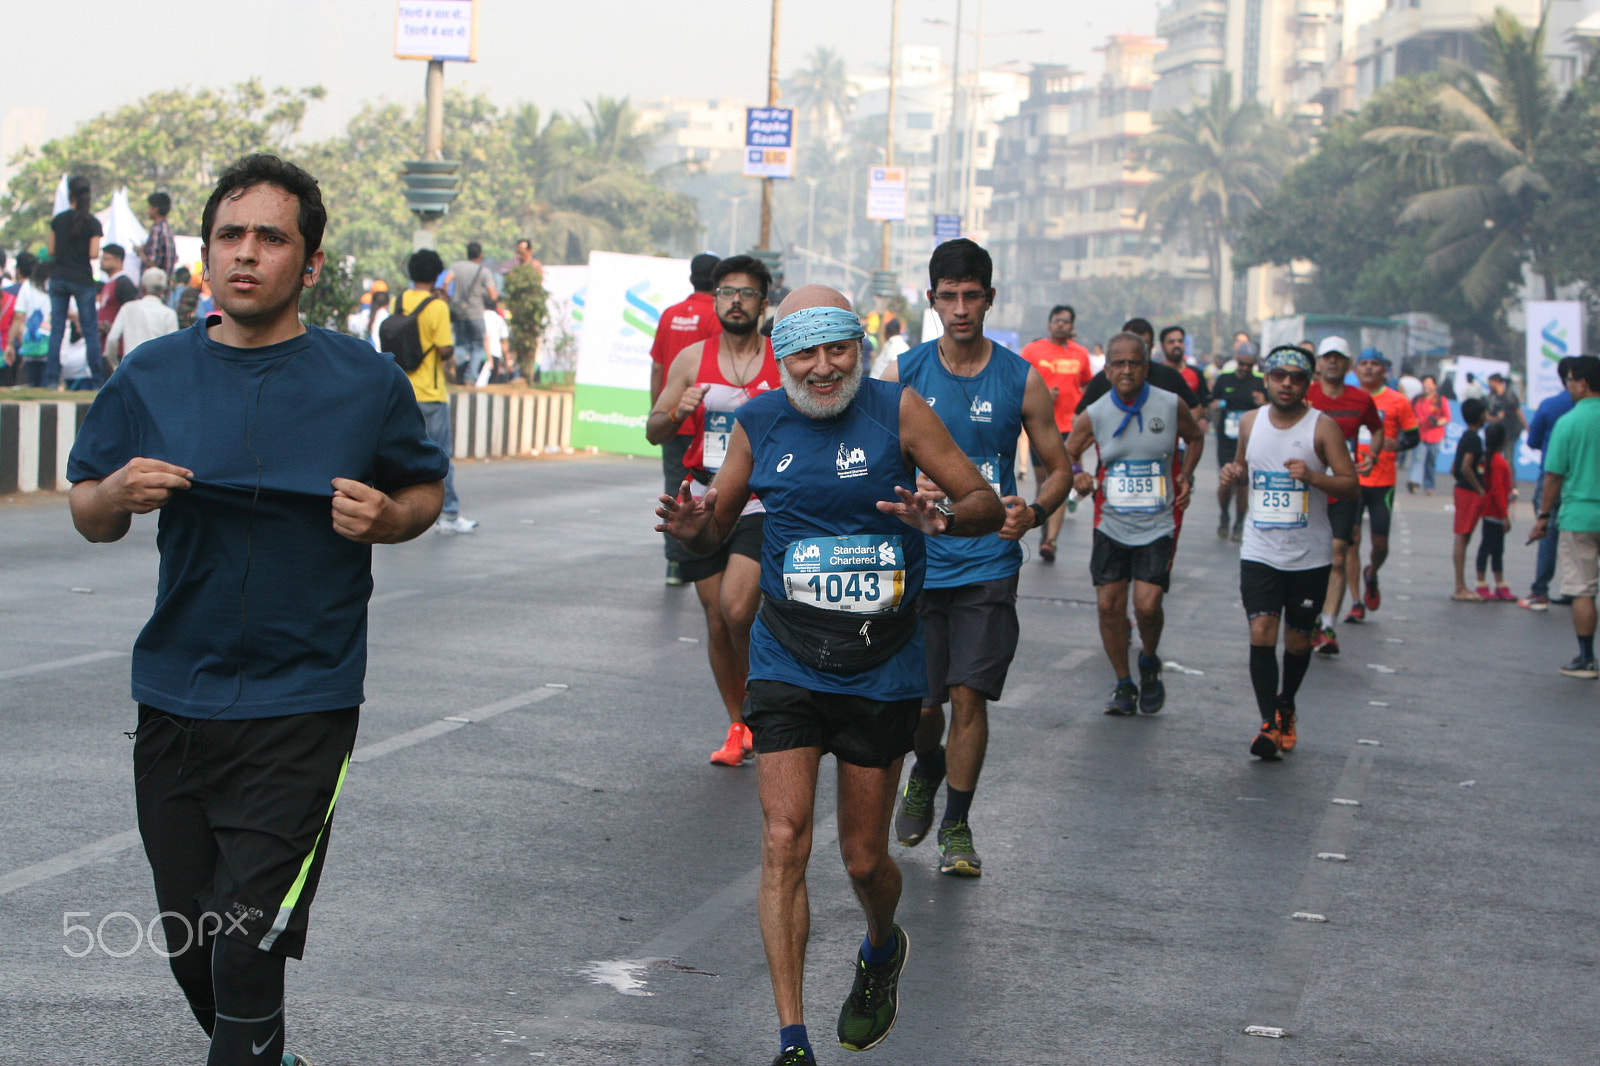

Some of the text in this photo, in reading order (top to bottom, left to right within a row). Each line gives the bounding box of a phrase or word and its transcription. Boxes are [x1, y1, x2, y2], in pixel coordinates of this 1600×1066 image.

[1118, 478, 1153, 493] 3859
[1263, 491, 1290, 507] 253
[833, 545, 875, 555] Standard
[829, 555, 876, 565] Chartered
[807, 571, 880, 603] 1043
